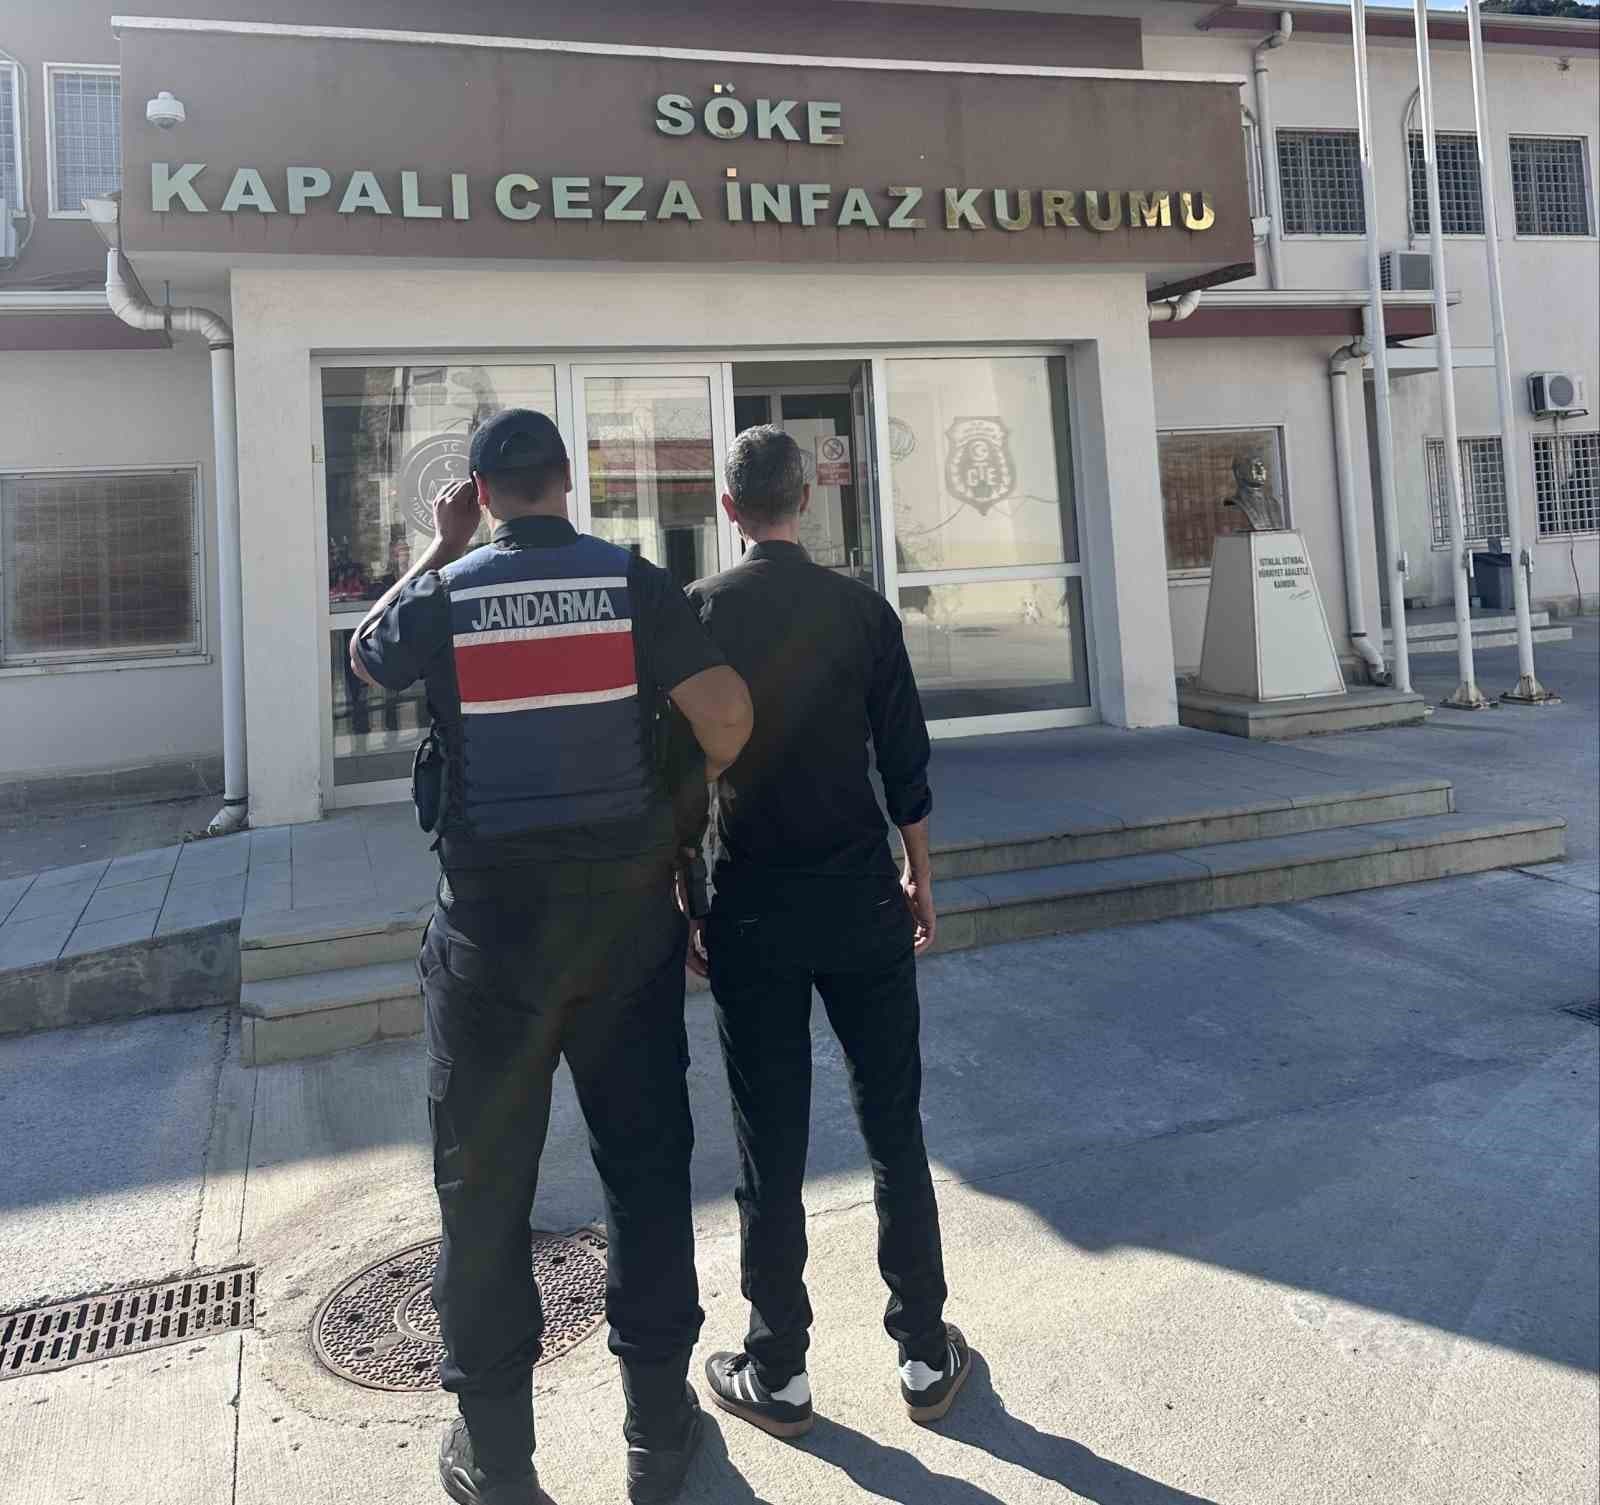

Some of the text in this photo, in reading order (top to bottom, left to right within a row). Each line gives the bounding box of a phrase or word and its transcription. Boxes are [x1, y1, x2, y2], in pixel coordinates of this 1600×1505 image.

[655, 83, 845, 145] SÖKE
[151, 162, 1216, 233] KAPALI CEZA İNFAZ KURUMU
[471, 589, 616, 630] JANDARMA
